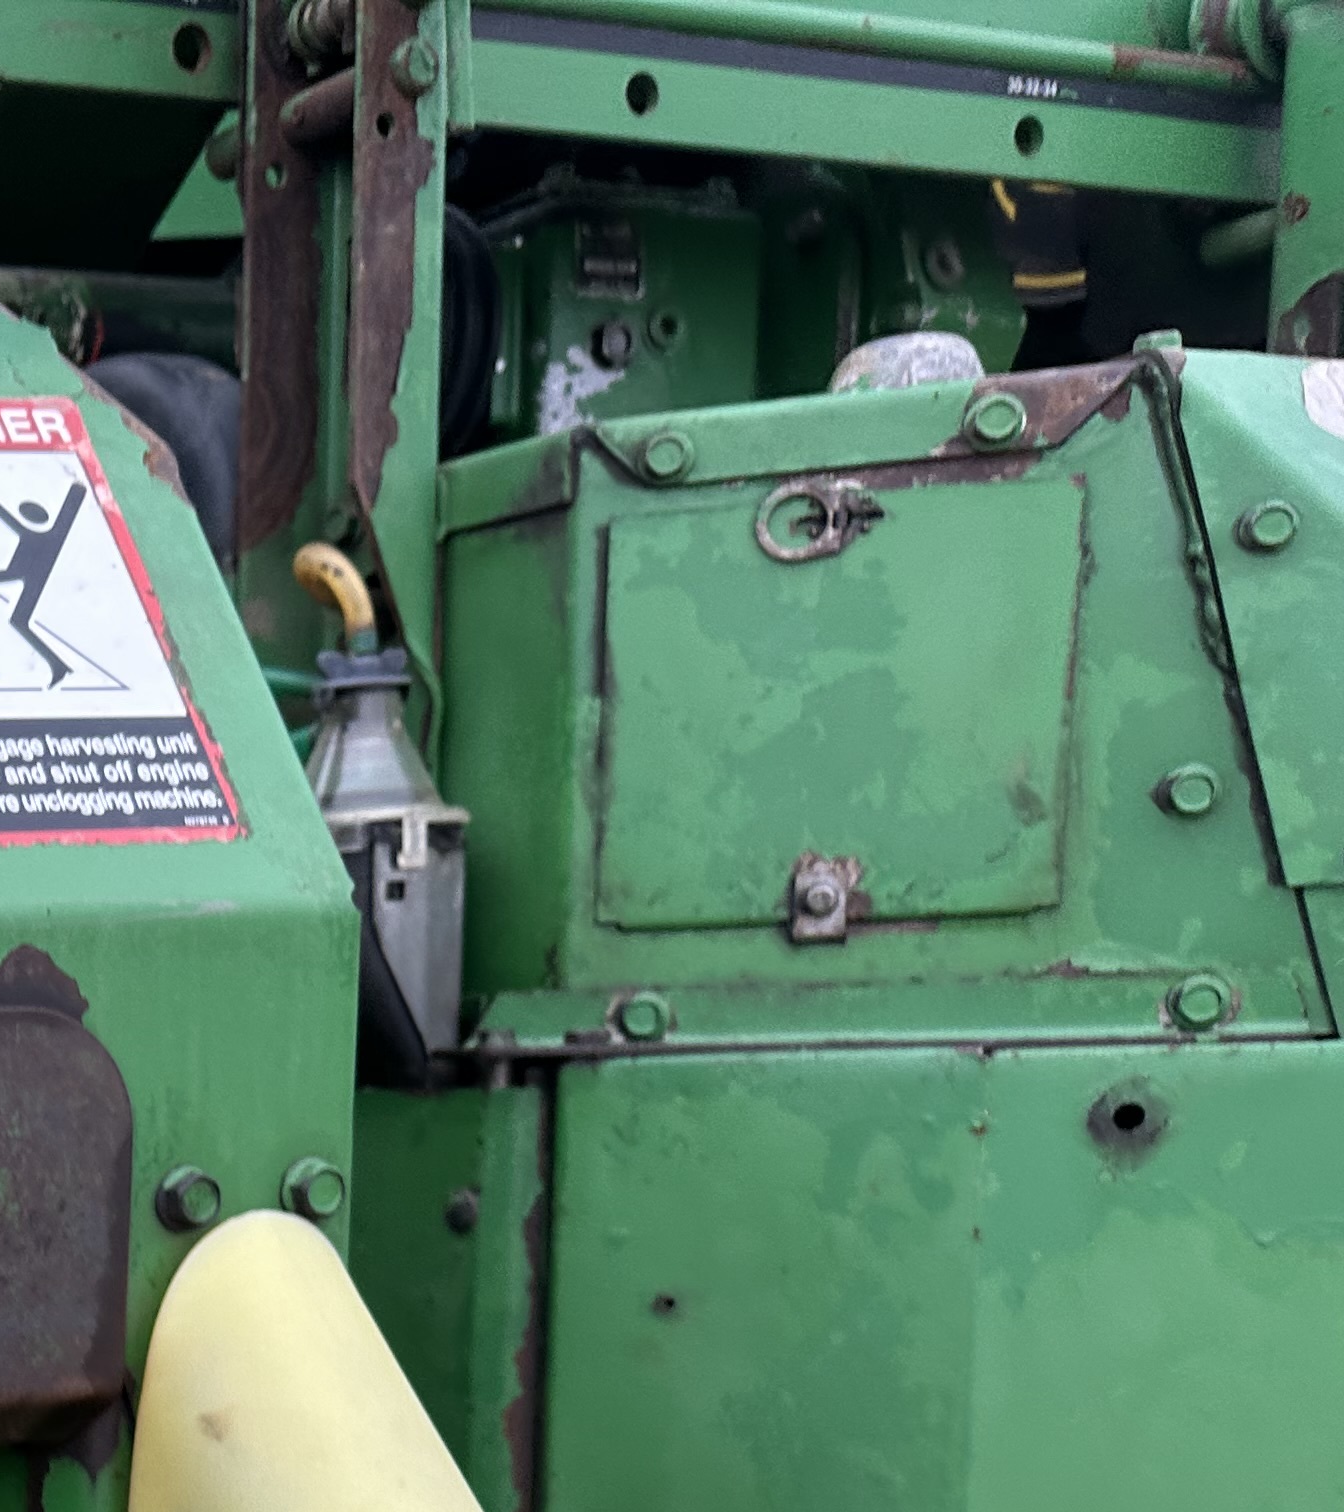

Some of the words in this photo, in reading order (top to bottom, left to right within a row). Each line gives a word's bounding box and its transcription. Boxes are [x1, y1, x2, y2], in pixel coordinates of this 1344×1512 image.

[45, 733, 155, 760] harvesting
[157, 731, 198, 755] unit
[4, 762, 47, 786] and
[50, 761, 101, 784] shut
[103, 759, 134, 783] off
[137, 760, 209, 787] engine
[21, 788, 134, 816] unclogging
[134, 785, 223, 810] machine.
